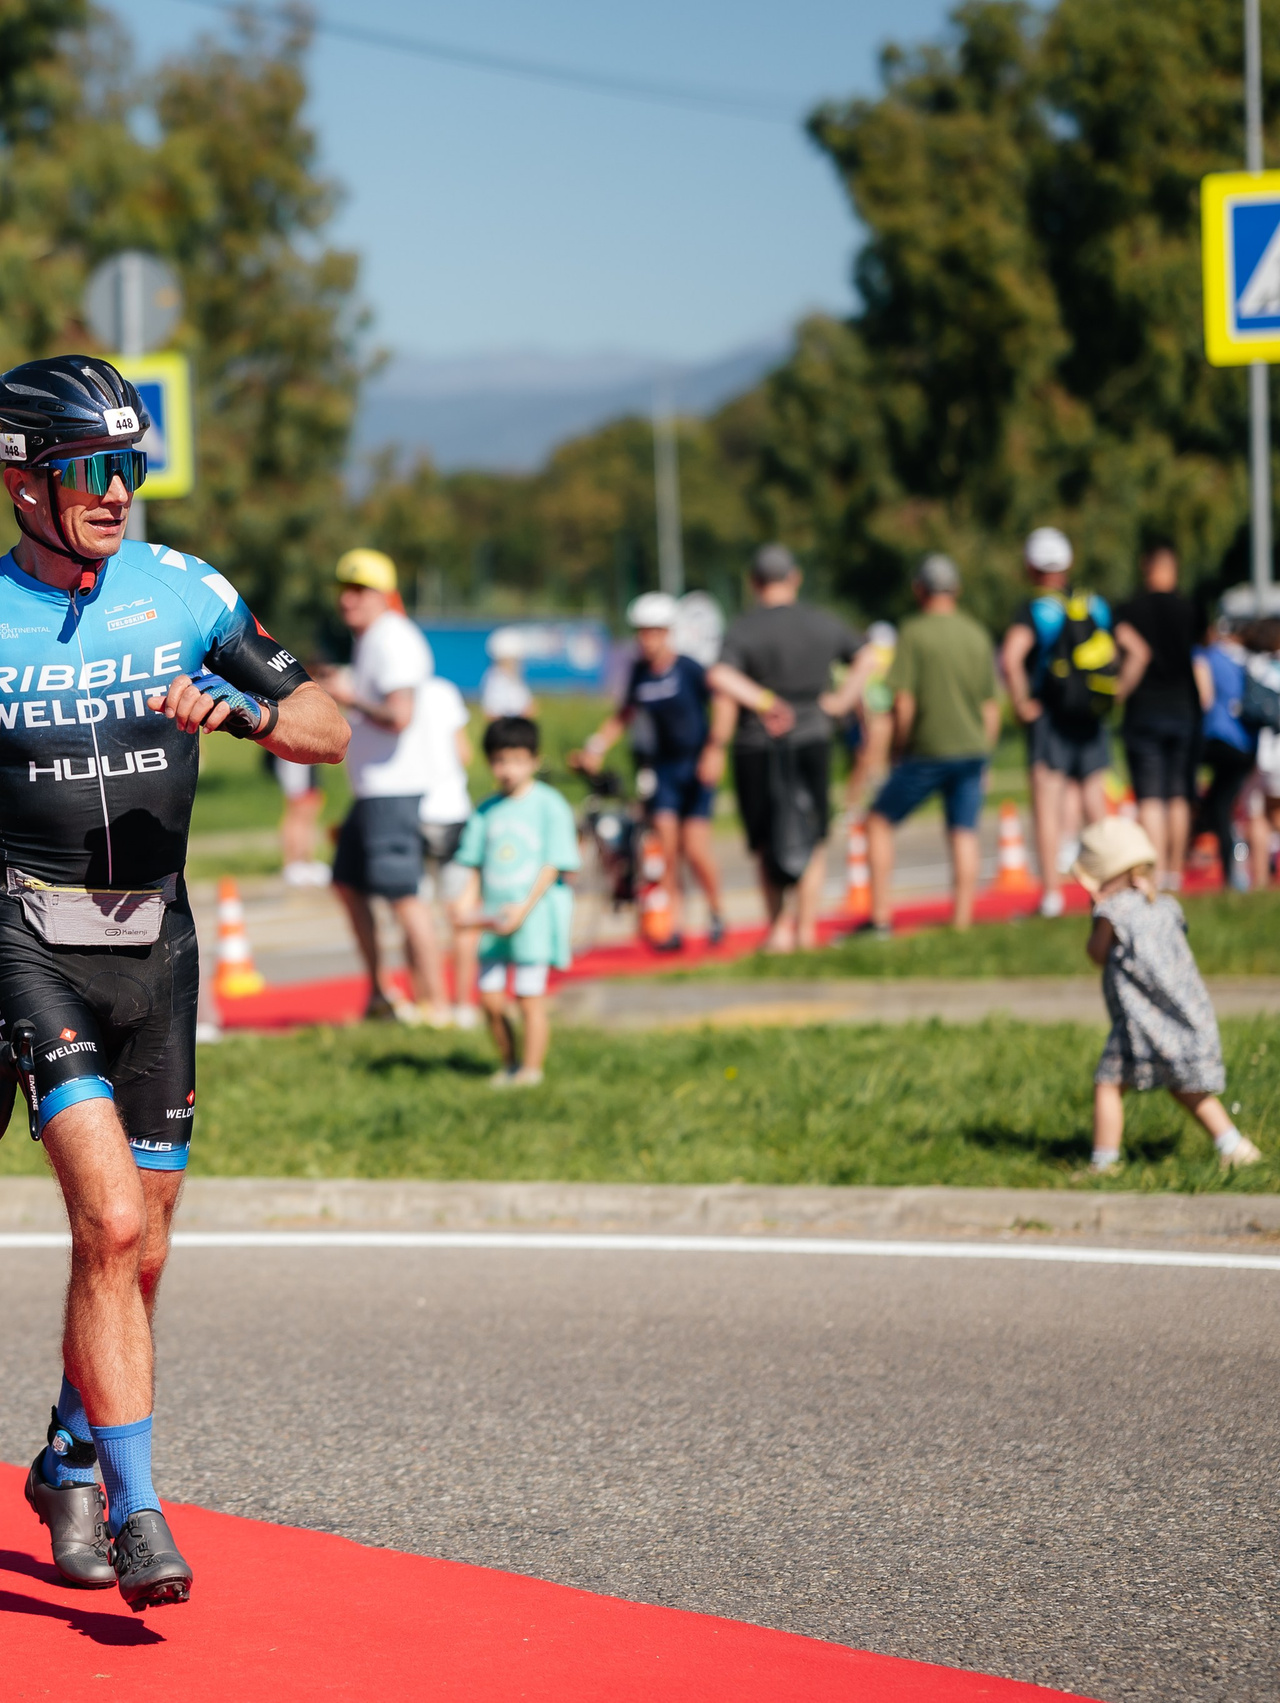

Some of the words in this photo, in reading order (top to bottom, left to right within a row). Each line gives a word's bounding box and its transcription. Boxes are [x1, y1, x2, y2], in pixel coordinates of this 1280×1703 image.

[115, 417, 134, 430] 448
[4, 445, 20, 457] 448
[110, 613, 145, 629] VELOSKIN
[28, 748, 169, 783] HUUB
[45, 1041, 98, 1063] WELDTITE
[28, 1074, 39, 1111] EMPIRE
[82, 1497, 90, 1517] SPORT
[150, 1518, 158, 1534] SPORT
